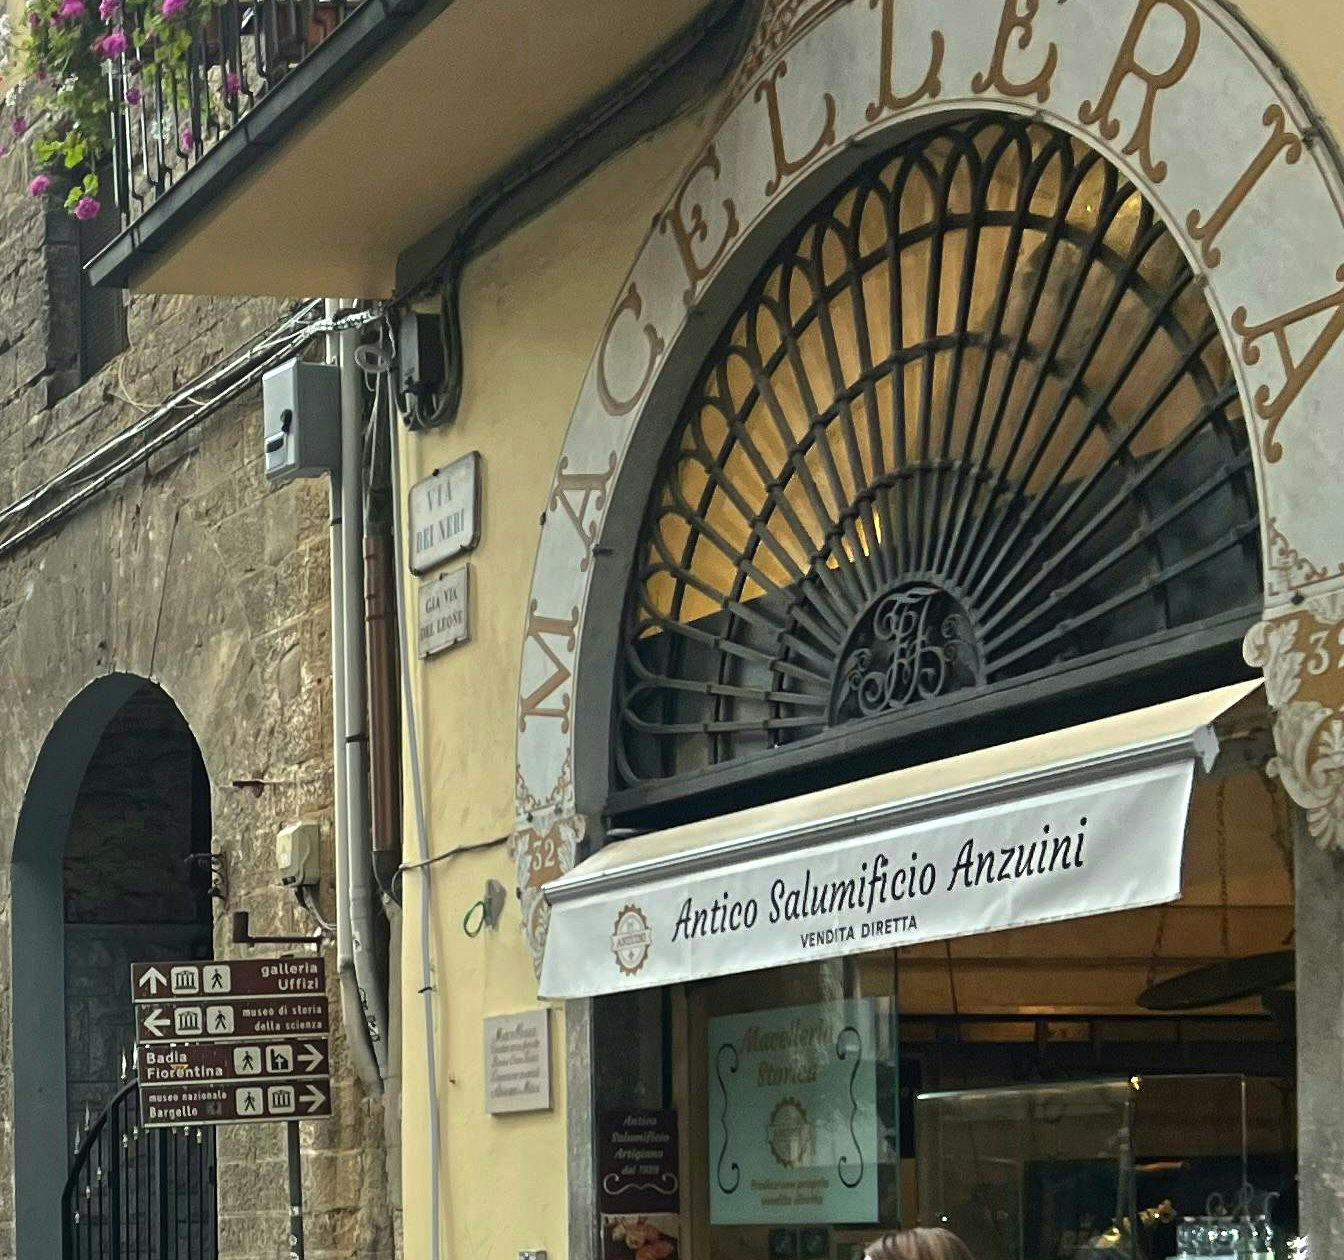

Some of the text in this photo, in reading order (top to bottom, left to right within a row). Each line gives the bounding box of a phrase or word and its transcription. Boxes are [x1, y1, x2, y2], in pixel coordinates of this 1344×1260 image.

[427, 480, 452, 511] VIA
[416, 508, 465, 553] DEI NERI
[420, 610, 463, 641] DEL LEONE
[533, 838, 555, 871] 32
[671, 816, 1088, 942] Antico Salumificio Anzuini
[800, 915, 917, 949] VENDITA DIRETTA
[261, 962, 318, 977] galleria
[278, 977, 319, 991] Uffizi
[242, 1004, 322, 1017] museo di storia
[254, 1021, 322, 1032] della scienza
[146, 1051, 188, 1065] Badia
[147, 1065, 223, 1080] Fiorentina
[148, 1091, 227, 1103] museo nazionale
[149, 1105, 198, 1119] Bargello
